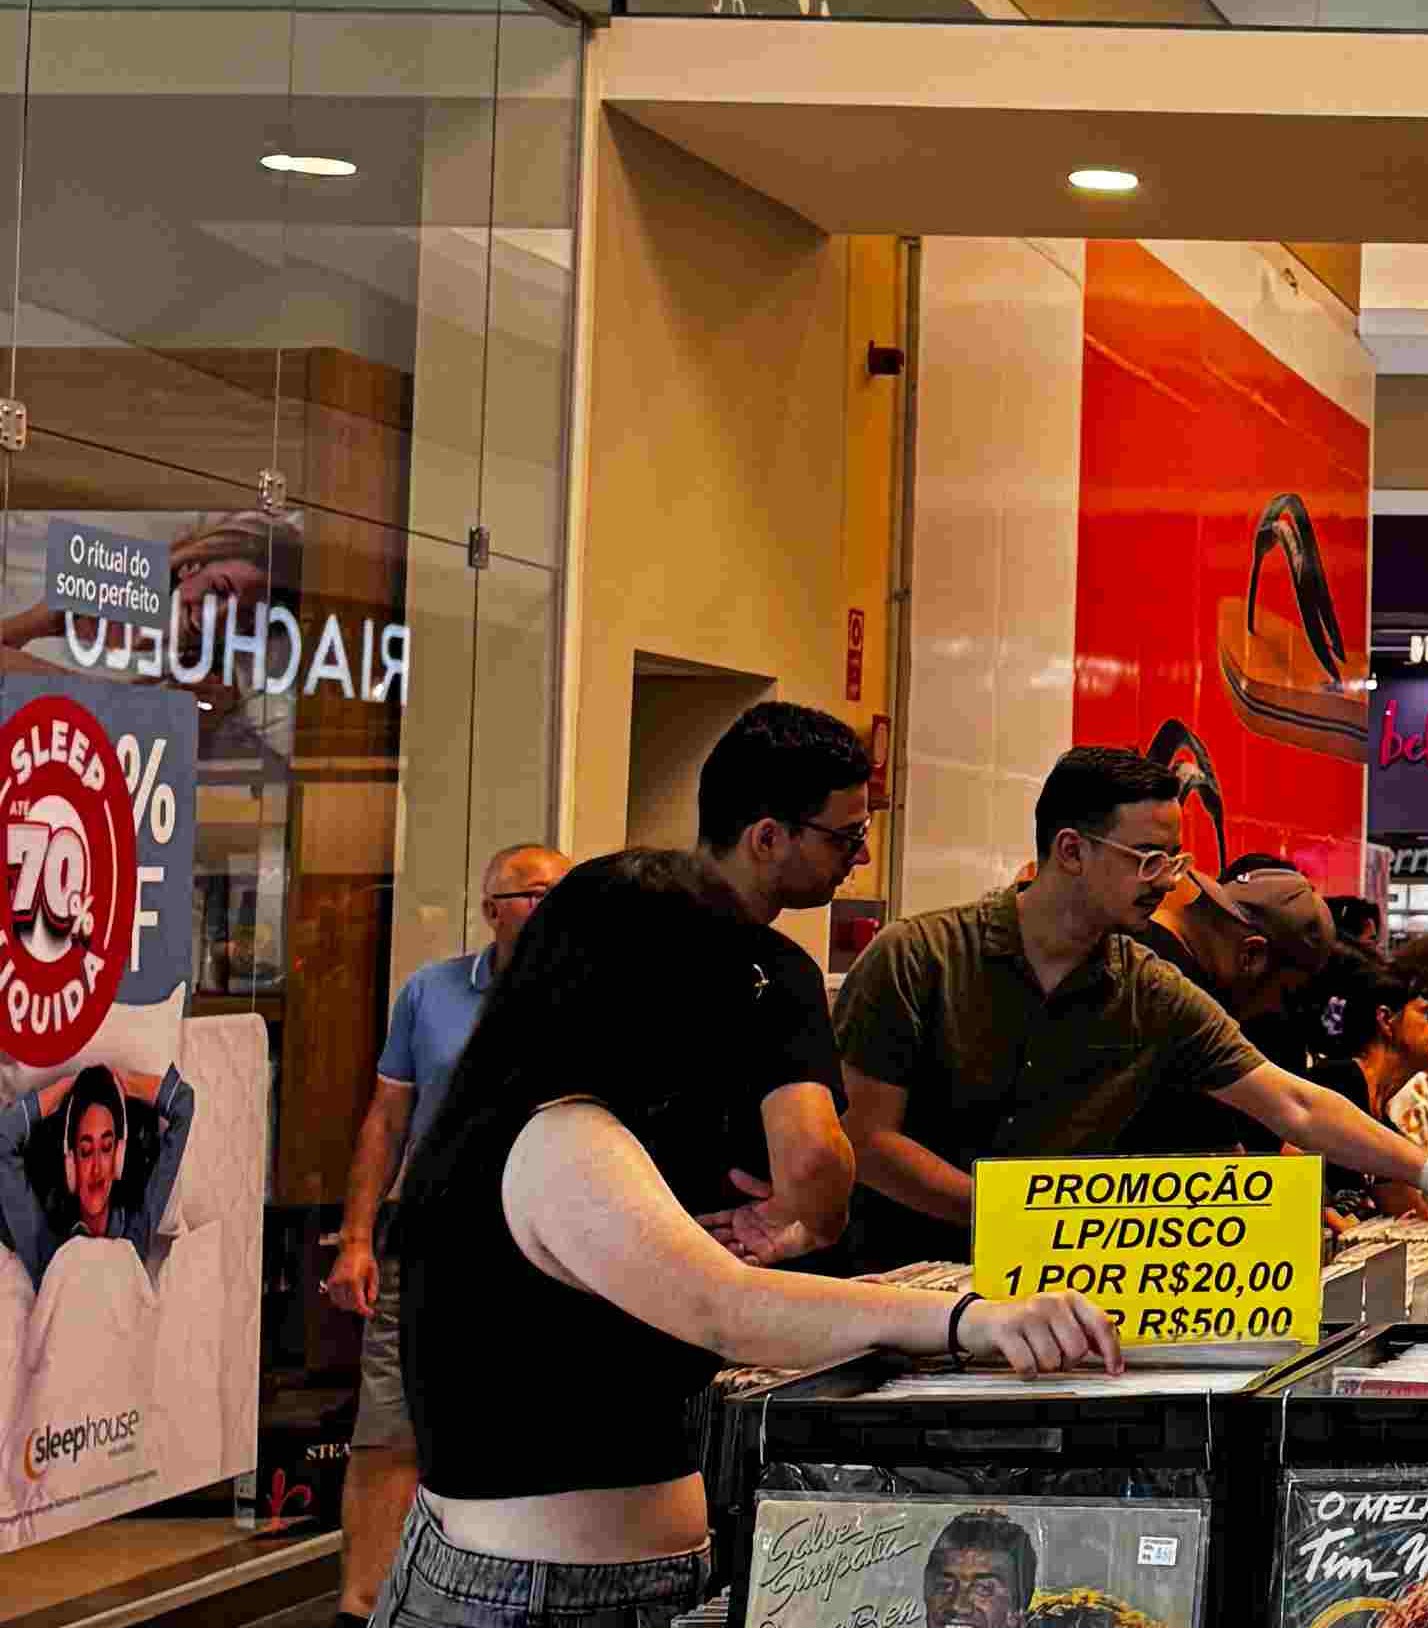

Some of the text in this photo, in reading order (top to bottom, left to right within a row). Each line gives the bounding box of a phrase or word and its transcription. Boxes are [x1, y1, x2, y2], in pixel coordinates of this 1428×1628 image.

[70, 534, 150, 579] O ritual do
[56, 572, 160, 614] sono perfeito
[10, 719, 106, 791] SLEEP
[1025, 1164, 1273, 1209] PROMOÇÃO
[1052, 1216, 1246, 1250] LP/DISCO
[1004, 1260, 1294, 1298] 1 POR R$20,00
[34, 1408, 139, 1464] sleephouse
[1314, 1491, 1346, 1521] O
[1299, 1526, 1399, 1583] Tim
